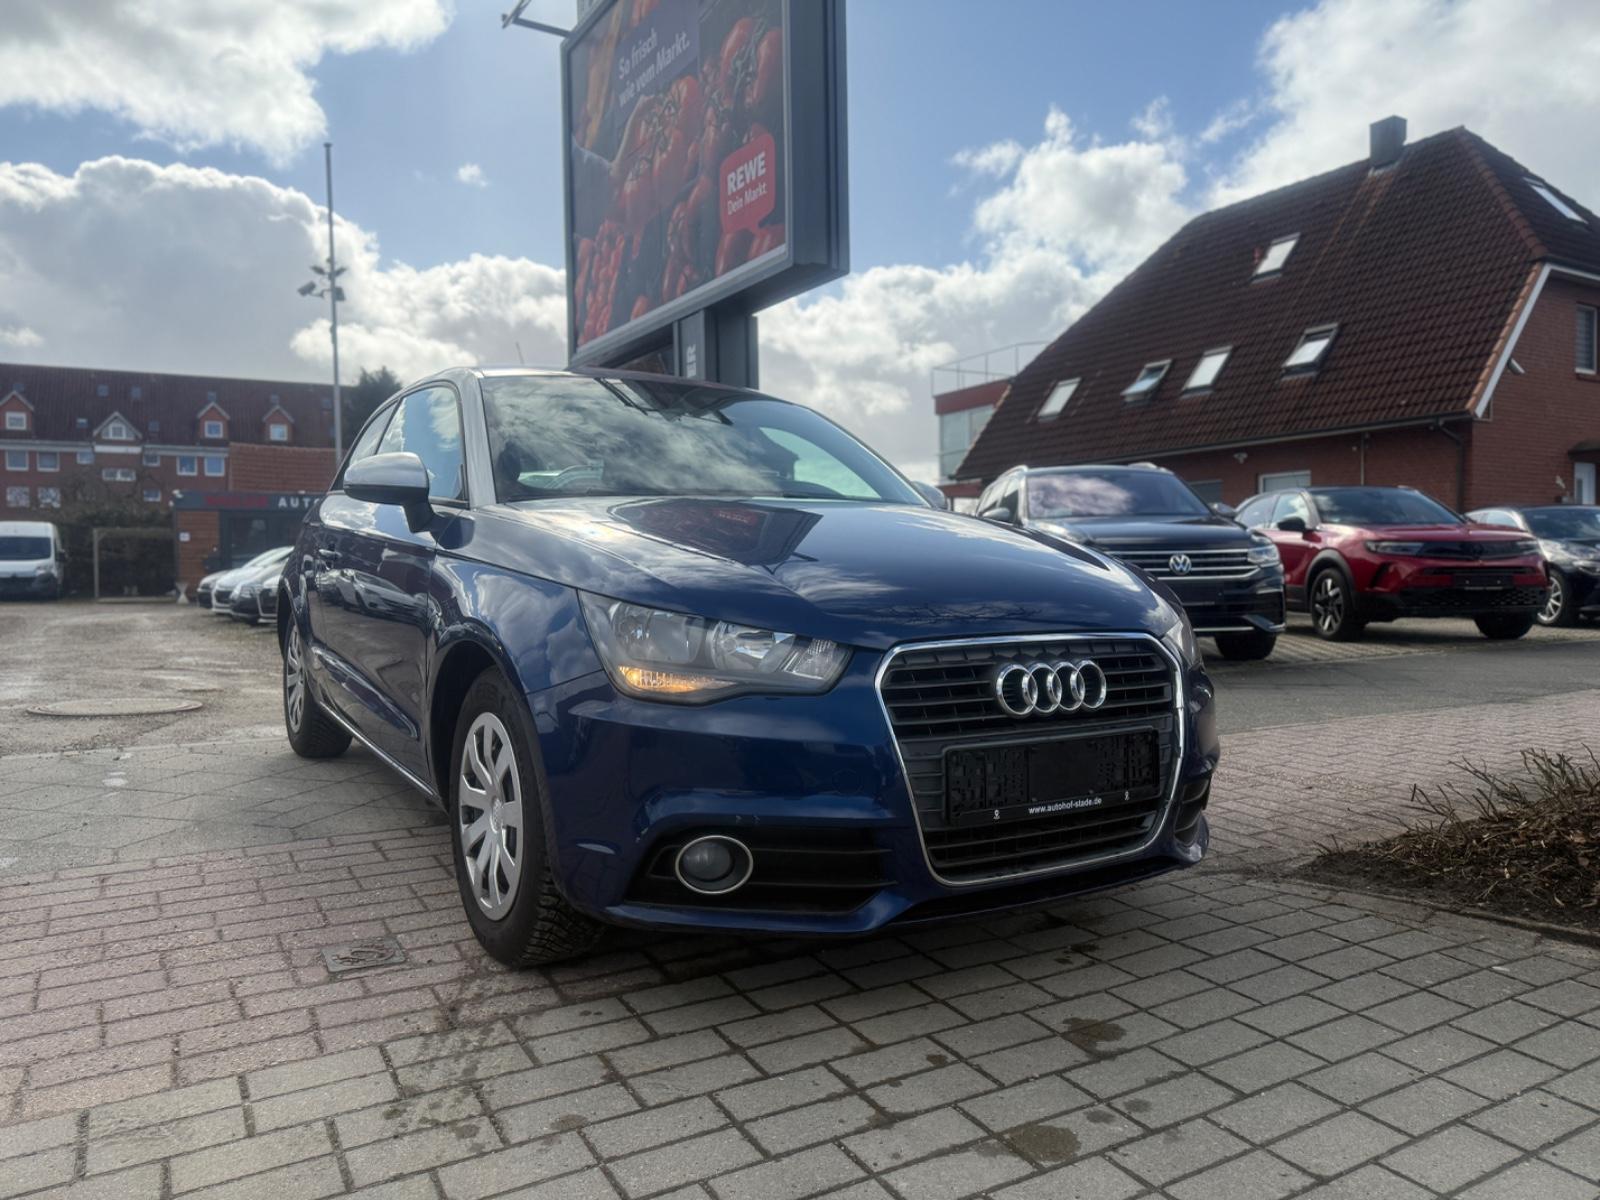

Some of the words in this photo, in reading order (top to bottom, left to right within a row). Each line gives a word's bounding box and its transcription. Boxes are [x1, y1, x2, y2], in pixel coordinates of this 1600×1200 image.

[619, 56, 631, 79] So
[631, 27, 657, 69] frisch
[619, 80, 636, 108] wie
[635, 63, 656, 92] vom
[656, 31, 690, 75] Markt.
[727, 151, 766, 196] REWE
[727, 196, 744, 215] Dein
[744, 182, 768, 206] Markt
[1169, 554, 1192, 576] VW
[1028, 797, 1102, 814] www.autohof-stade.de
